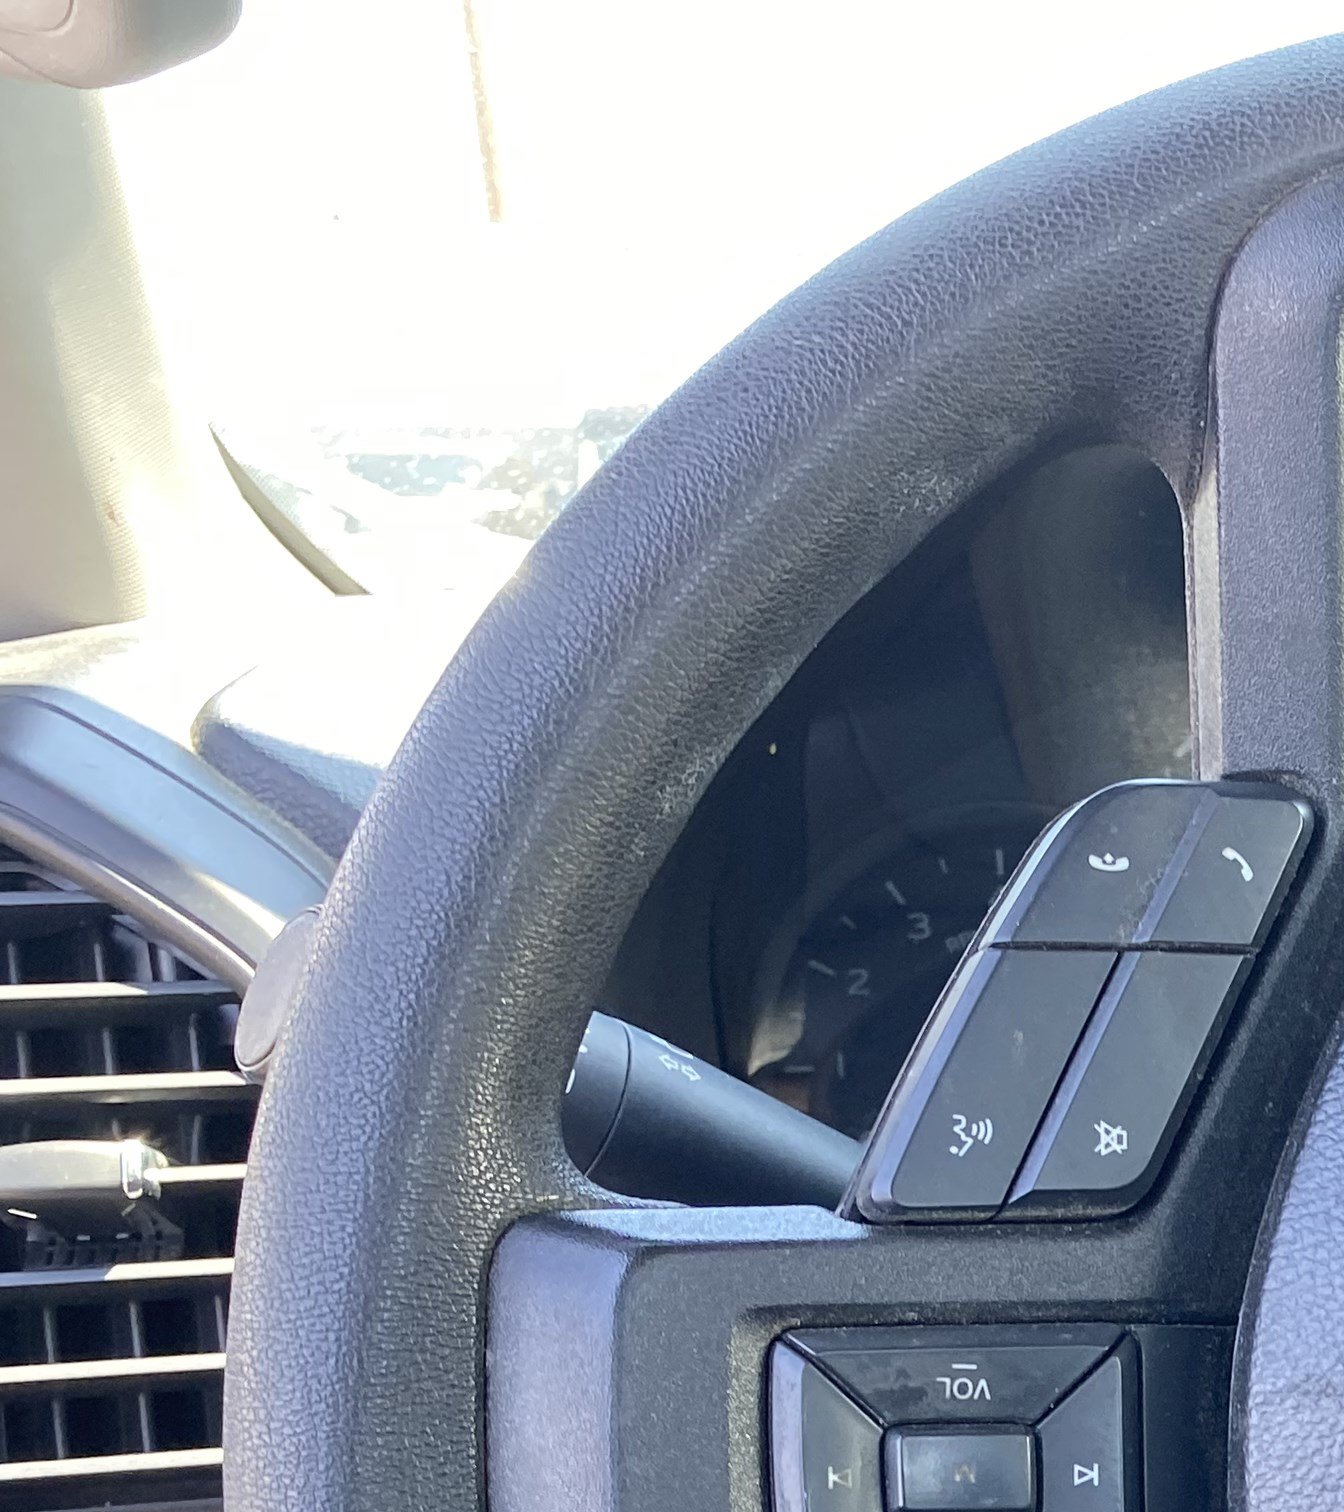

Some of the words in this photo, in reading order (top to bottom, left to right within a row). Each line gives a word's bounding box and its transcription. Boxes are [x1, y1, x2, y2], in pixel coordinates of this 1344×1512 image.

[906, 912, 931, 943] 3
[848, 968, 870, 997] 2
[936, 1377, 992, 1401] VOL
